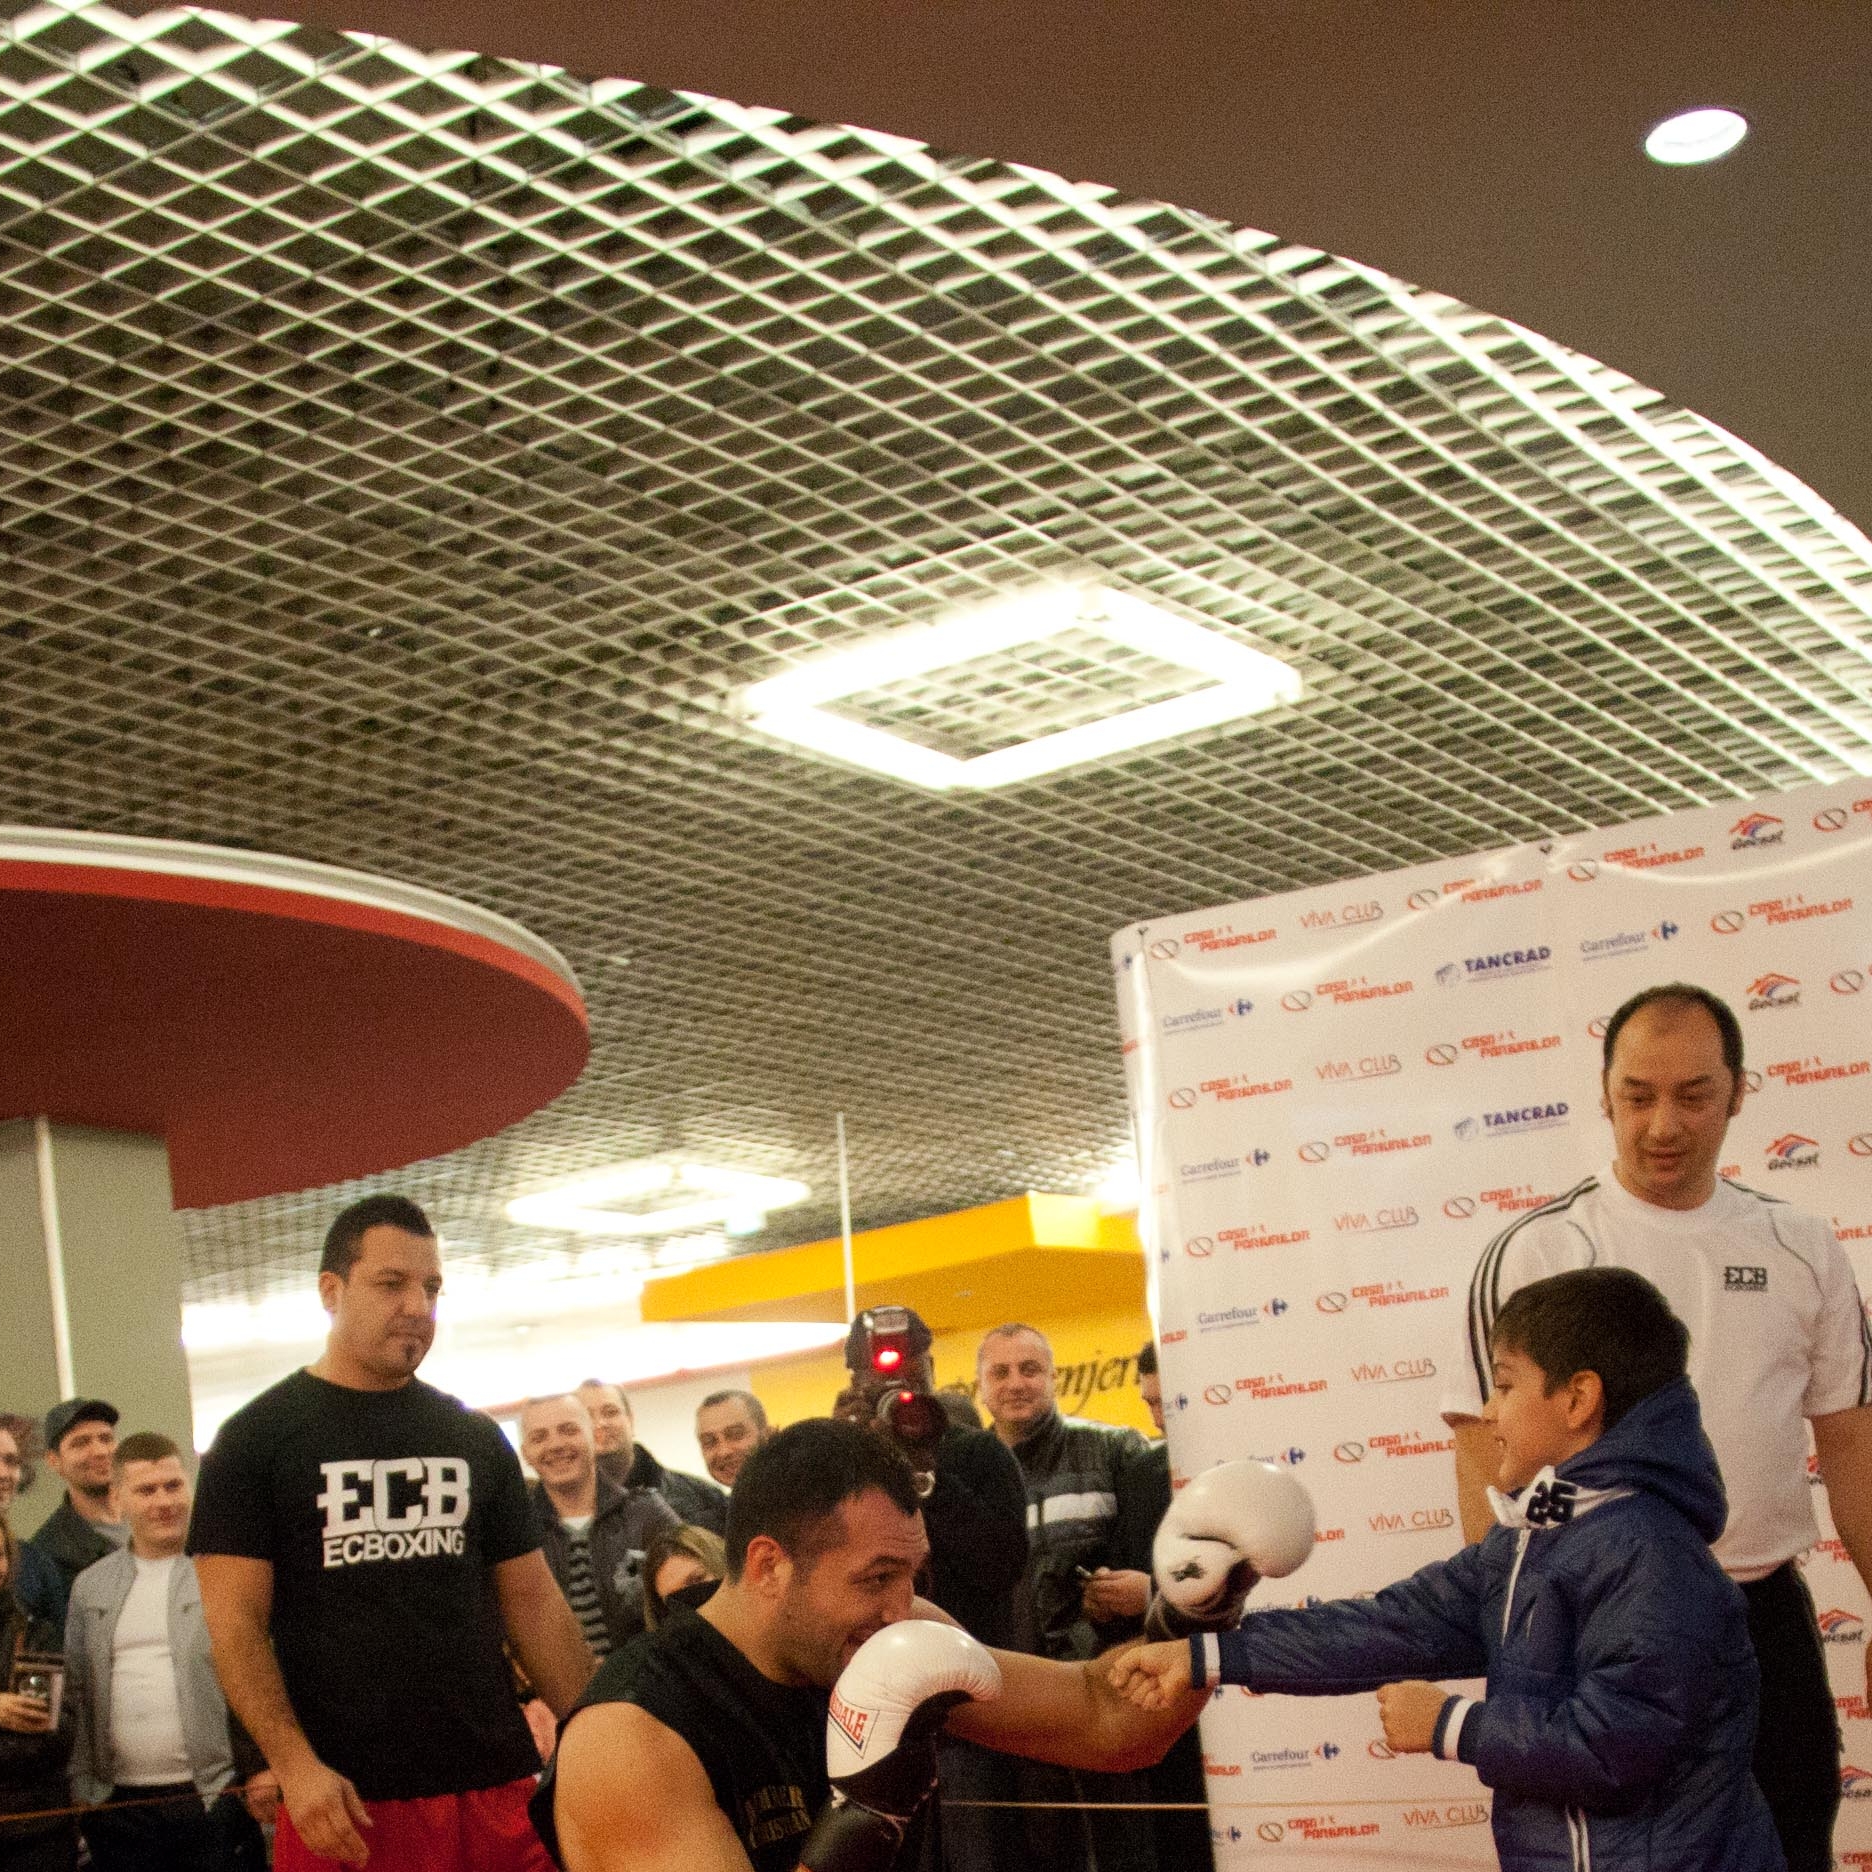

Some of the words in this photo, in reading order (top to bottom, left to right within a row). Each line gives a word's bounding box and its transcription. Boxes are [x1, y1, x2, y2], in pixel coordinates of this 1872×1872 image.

[1342, 901, 1384, 922] CLUB
[1581, 931, 1645, 953] Carrefour
[1465, 947, 1550, 972] TANCRAD
[1161, 1007, 1223, 1027] Carrefour
[1359, 1054, 1402, 1074] CLUB
[1484, 1102, 1568, 1126] TANCRAD
[1181, 1158, 1239, 1176] Carrefour
[1378, 1206, 1419, 1226] CLUB
[1199, 1306, 1257, 1324] Carrefour
[1394, 1358, 1437, 1377] CLUB
[316, 1457, 471, 1537] ECB
[1411, 1509, 1454, 1528] CLUB
[323, 1528, 466, 1570] ECBOXING
[1251, 1748, 1308, 1763] Carrefour
[1446, 1804, 1489, 1823] CLUB
